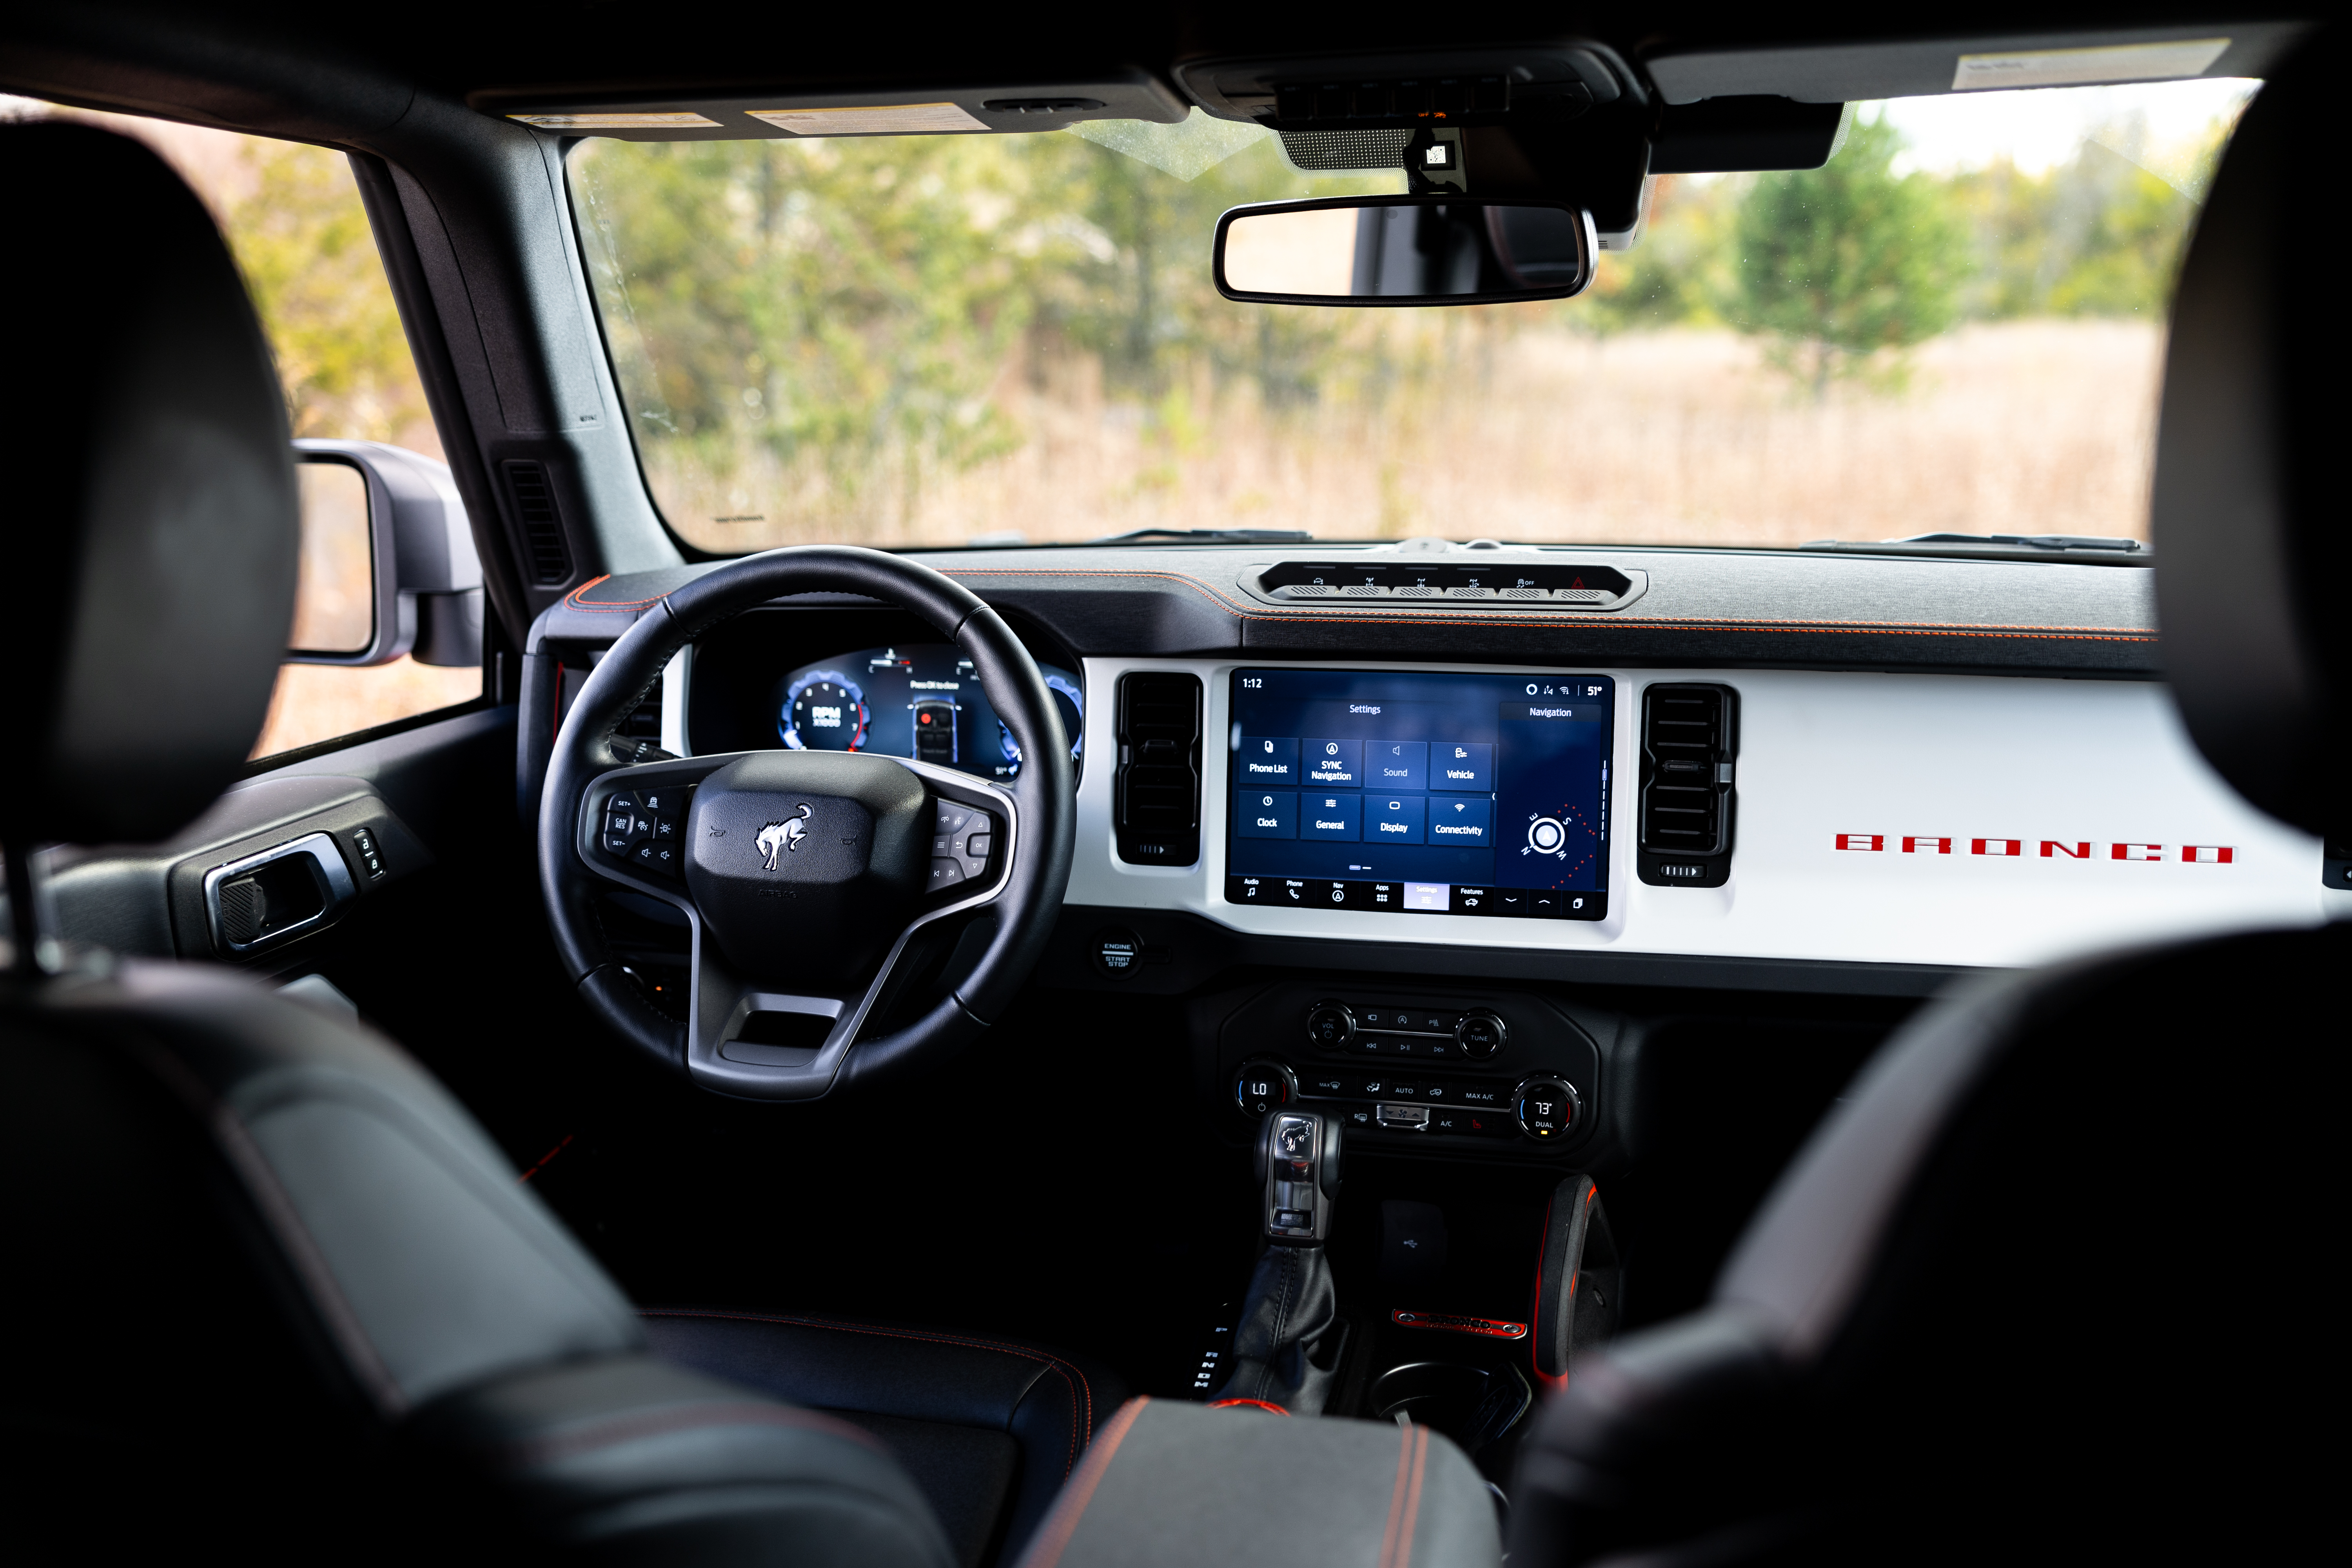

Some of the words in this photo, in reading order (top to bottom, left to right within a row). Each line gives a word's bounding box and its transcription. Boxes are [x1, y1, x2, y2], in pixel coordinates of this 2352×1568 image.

[1243, 678, 1262, 688] 1:12
[1587, 686, 1602, 696] 51°
[812, 706, 841, 719] RPM
[1349, 704, 1381, 715] Settings
[1530, 707, 1572, 718] Navigation
[1249, 763, 1274, 773] Phone
[1274, 764, 1288, 773] List
[1321, 760, 1342, 770] SYNC
[1311, 771, 1352, 781] Navigation
[1383, 768, 1408, 777] Sound
[1446, 769, 1474, 779] Vehicle
[1257, 818, 1278, 827] Clock
[1529, 813, 1539, 822] E
[1563, 817, 1572, 825] S
[1316, 820, 1345, 829] General
[1380, 822, 1408, 833] Display
[1435, 824, 1483, 836] Connectivity
[1831, 833, 2238, 864] BRONCO
[1555, 849, 1567, 860] W
[759, 890, 799, 898] AIRBAG
[1416, 886, 1438, 894] Settings
[1427, 1315, 1492, 1330] BRONCO
